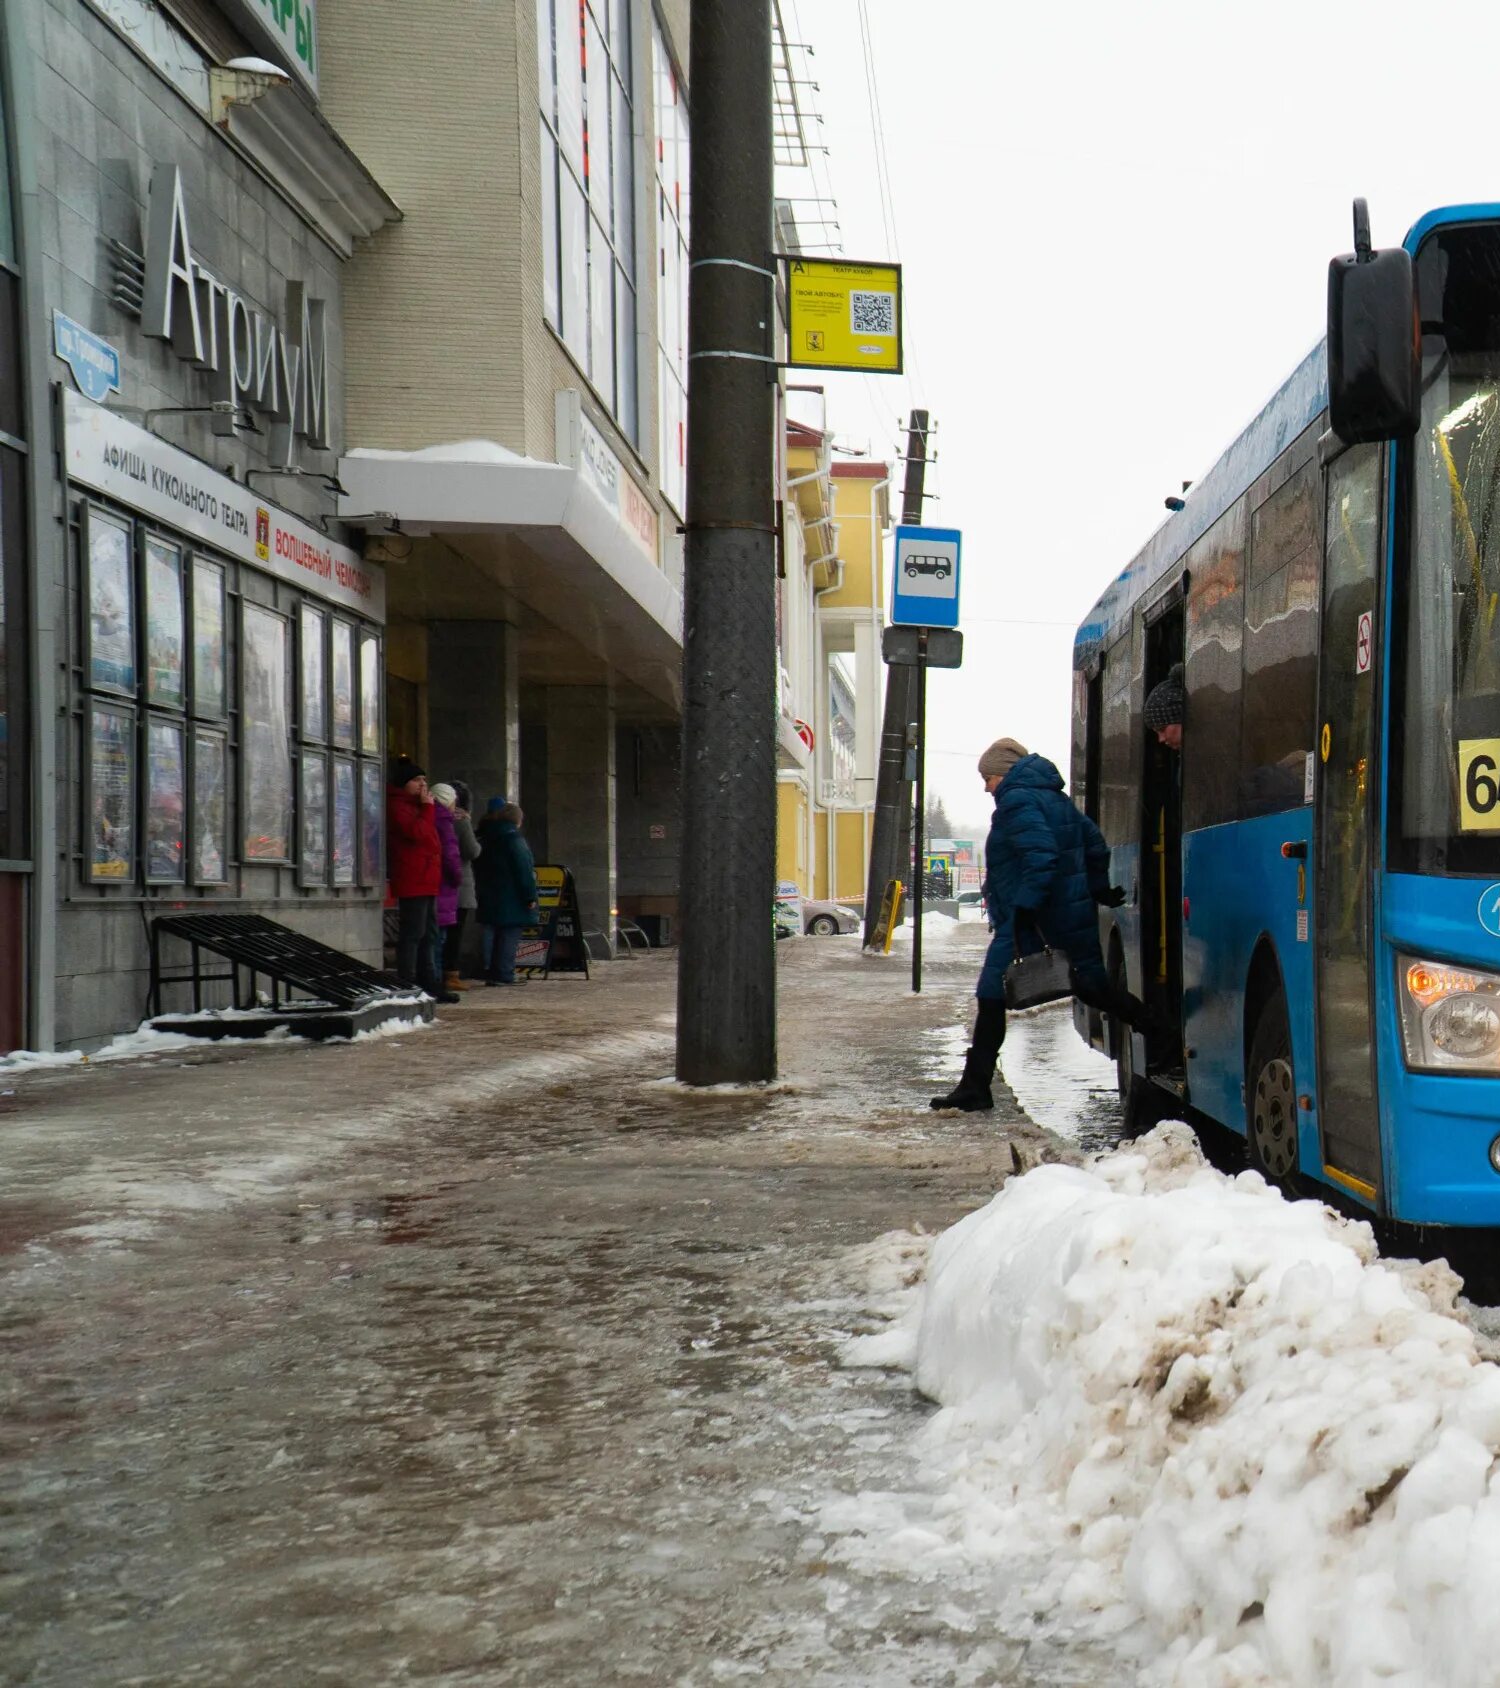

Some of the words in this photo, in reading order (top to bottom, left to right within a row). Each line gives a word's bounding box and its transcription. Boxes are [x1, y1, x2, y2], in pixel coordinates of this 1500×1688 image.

[103, 440, 148, 485] АФИША
[151, 464, 218, 520] КУКОЛЬНОГО
[221, 501, 250, 538] ТЕАТРА
[275, 528, 332, 580] ВОЛШЕБНЫЙ
